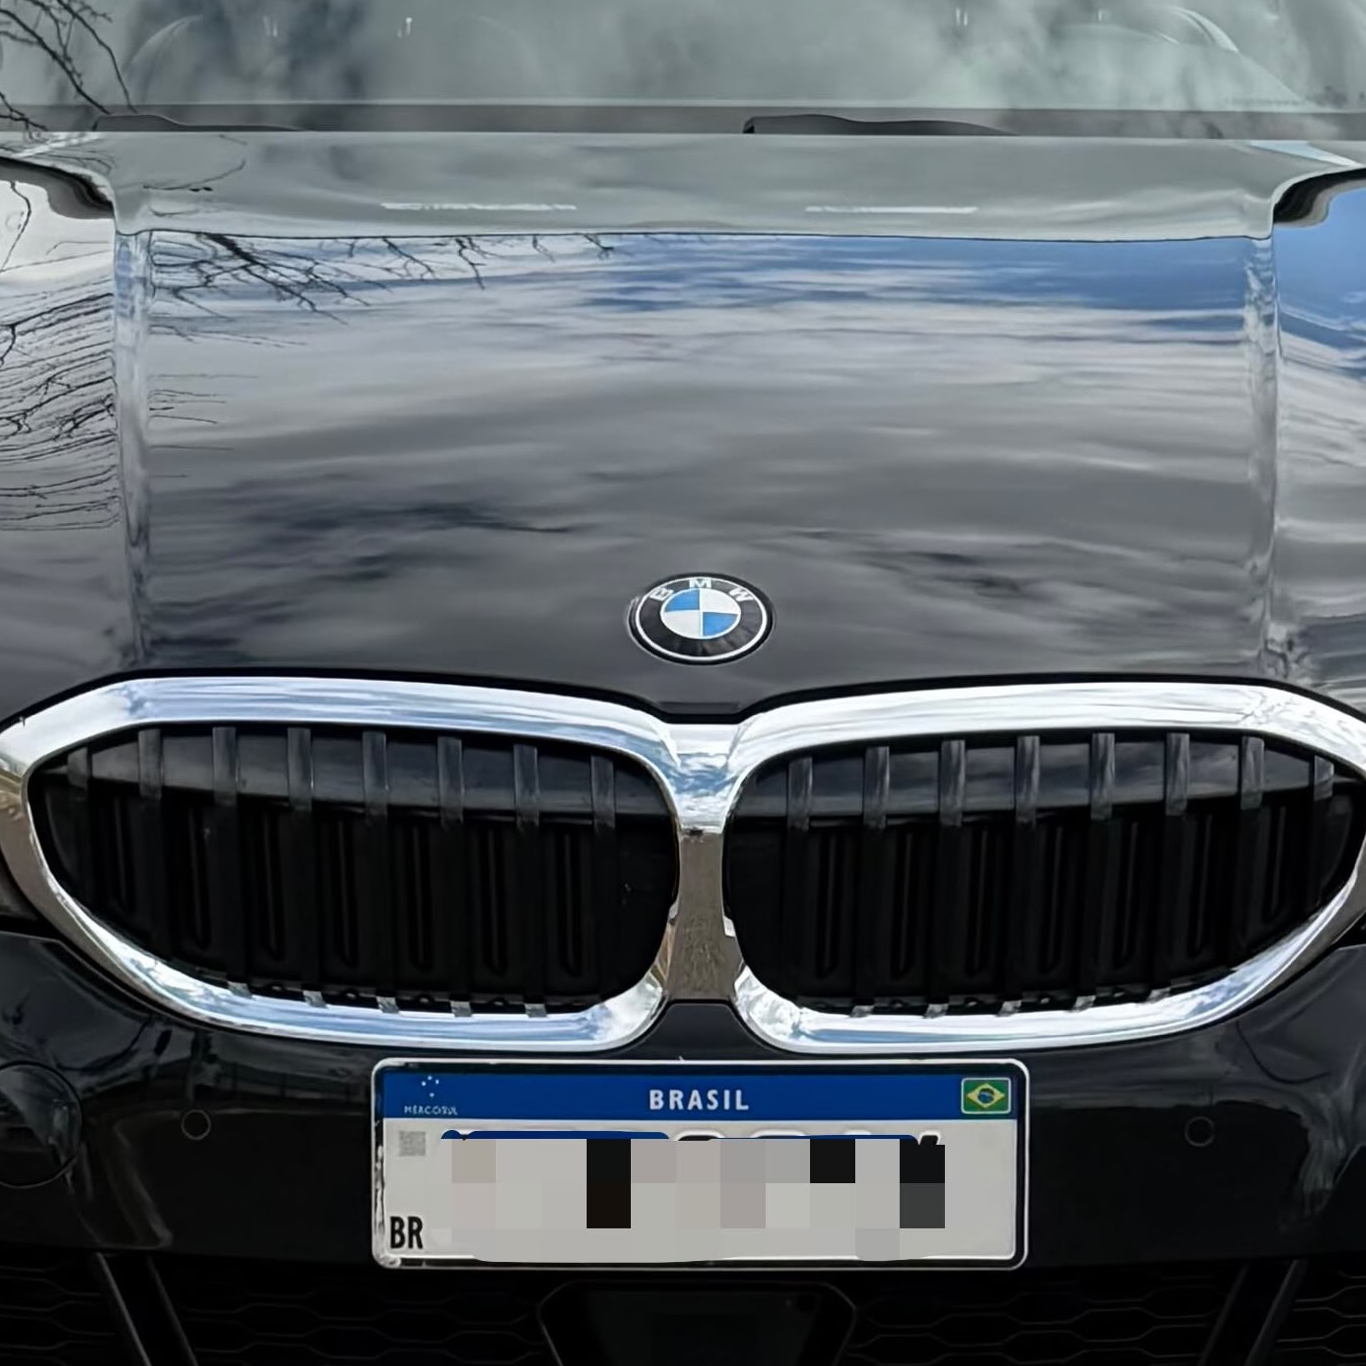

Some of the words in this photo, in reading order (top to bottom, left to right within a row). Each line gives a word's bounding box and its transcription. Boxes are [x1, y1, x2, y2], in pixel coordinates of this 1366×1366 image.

[649, 578, 754, 602] BMW
[649, 1088, 750, 1111] BRASIL
[389, 1215, 424, 1250] BR
